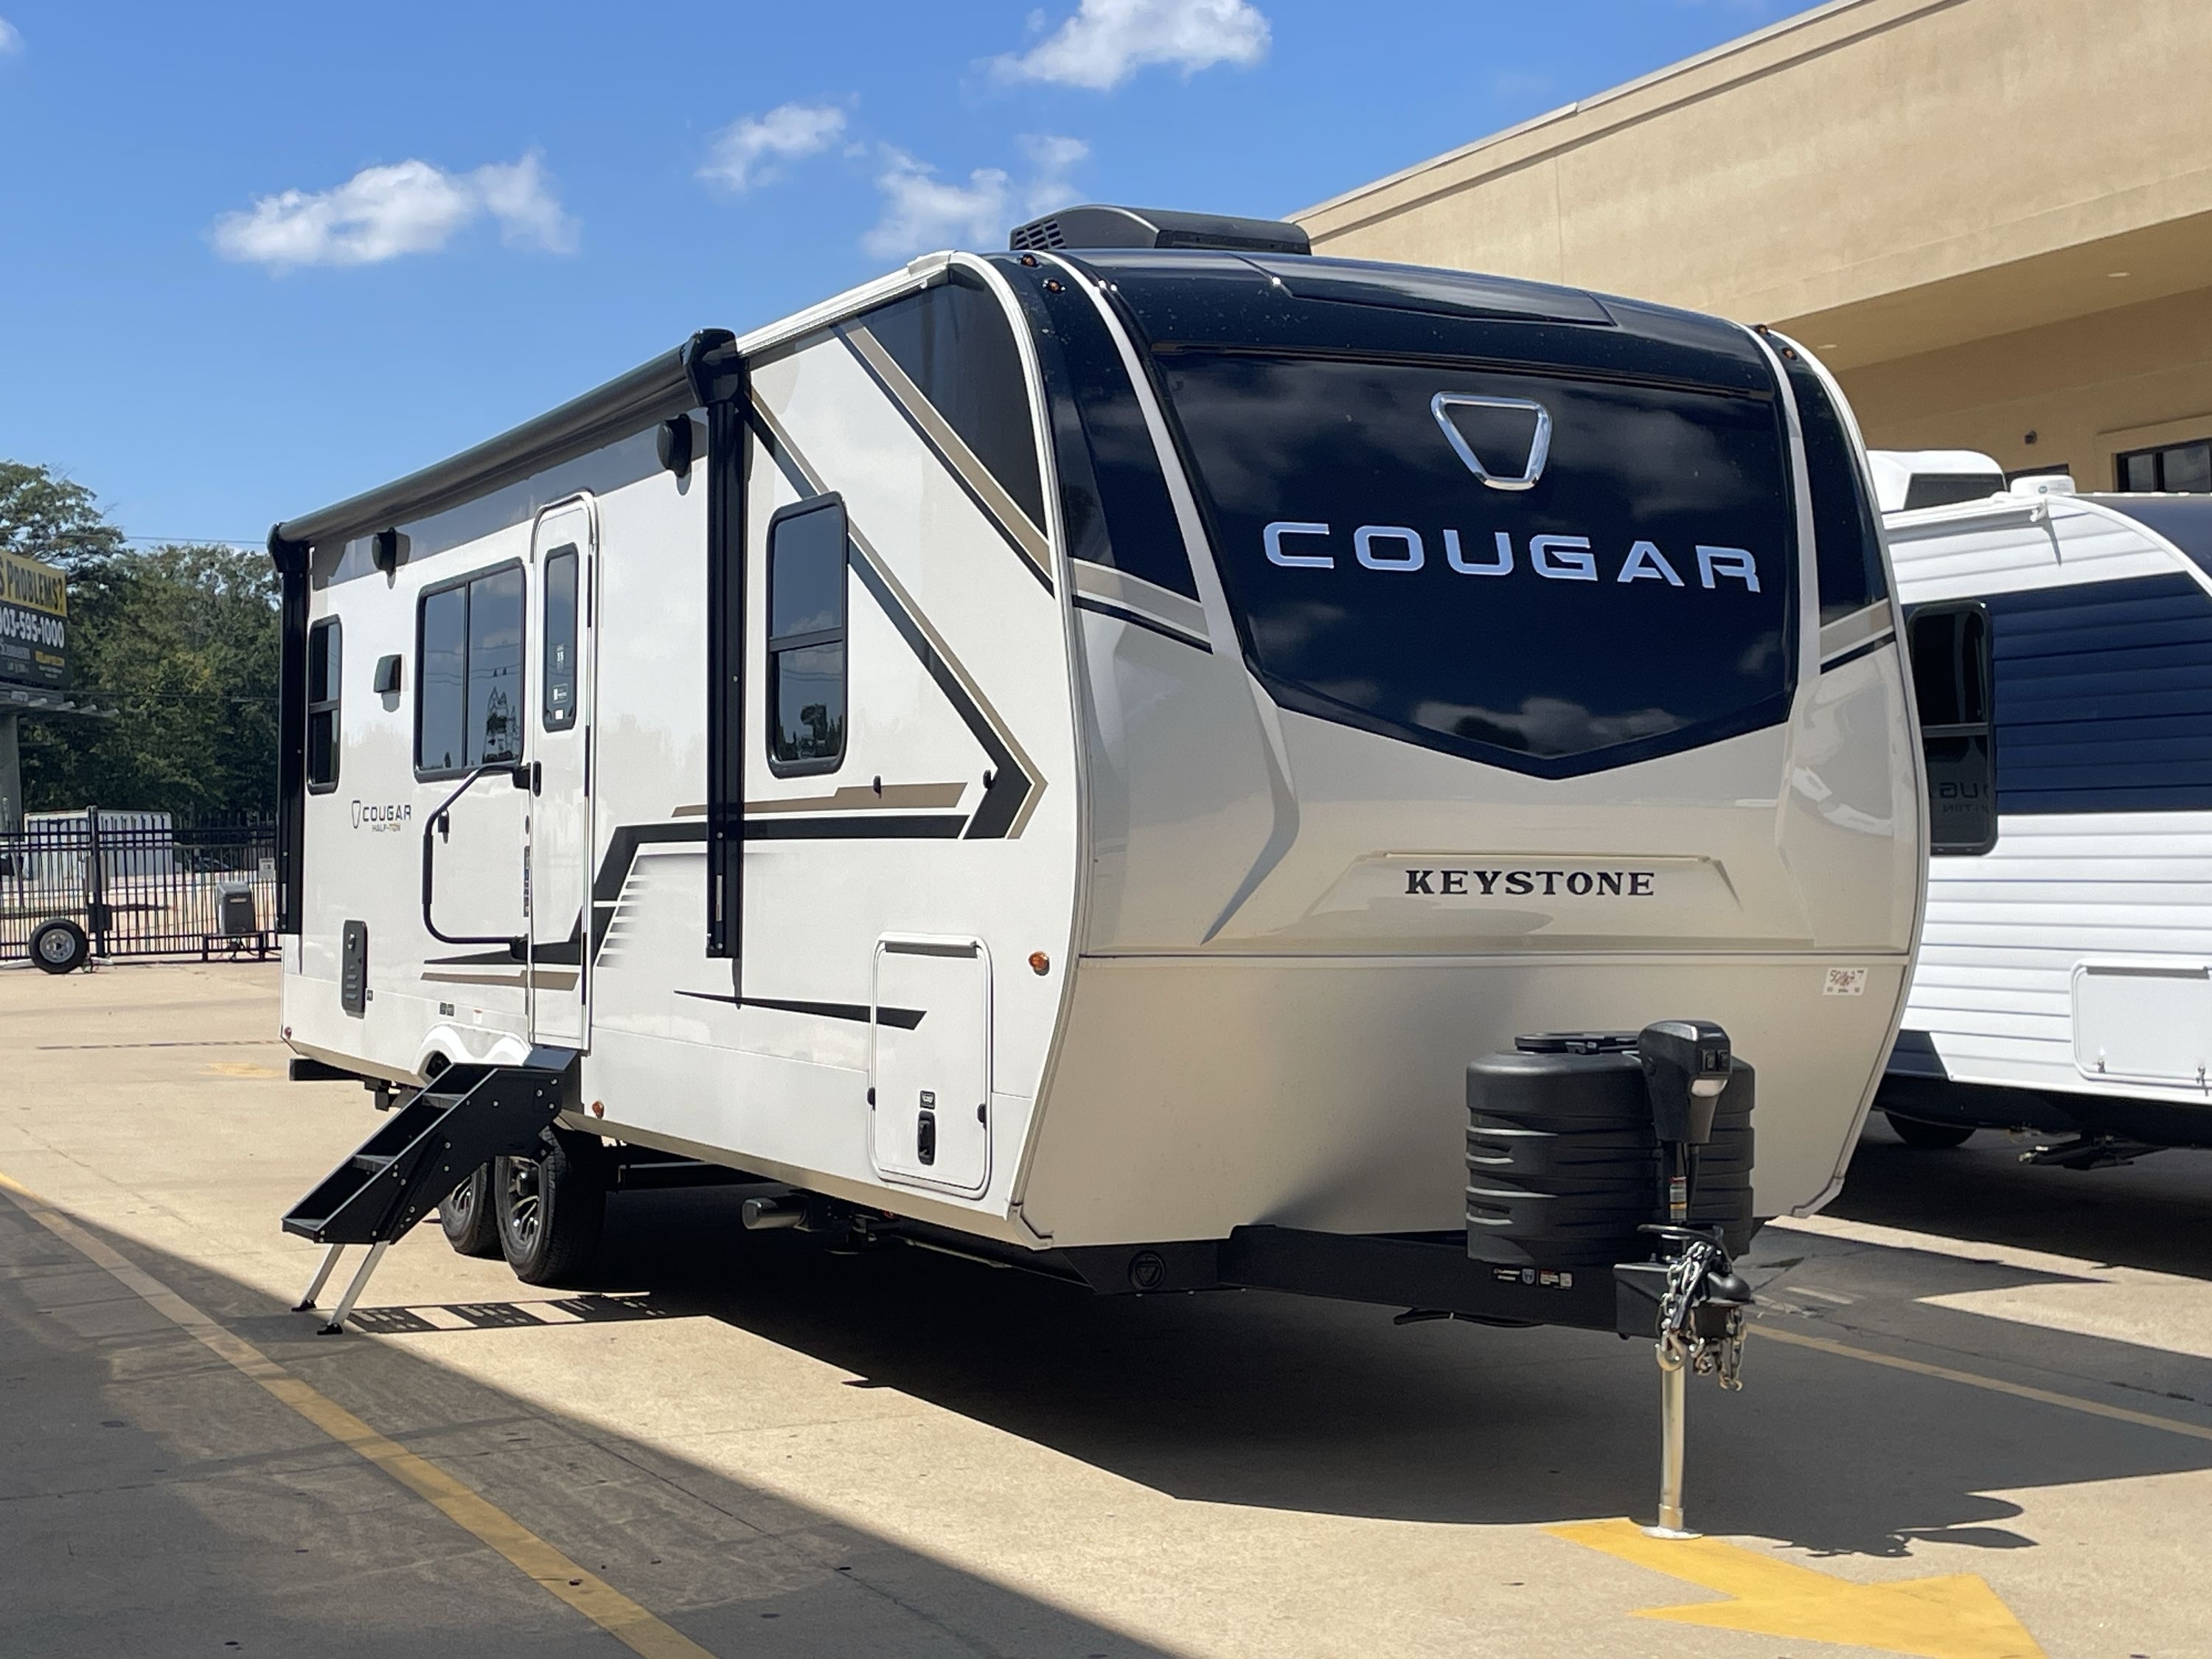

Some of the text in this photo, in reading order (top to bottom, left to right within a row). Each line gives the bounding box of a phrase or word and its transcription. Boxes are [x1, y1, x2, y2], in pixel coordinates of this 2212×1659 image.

[1262, 521, 1761, 593] COUGAR
[362, 804, 412, 822] COUGAR
[1405, 869, 1655, 896] KEYSTONE
